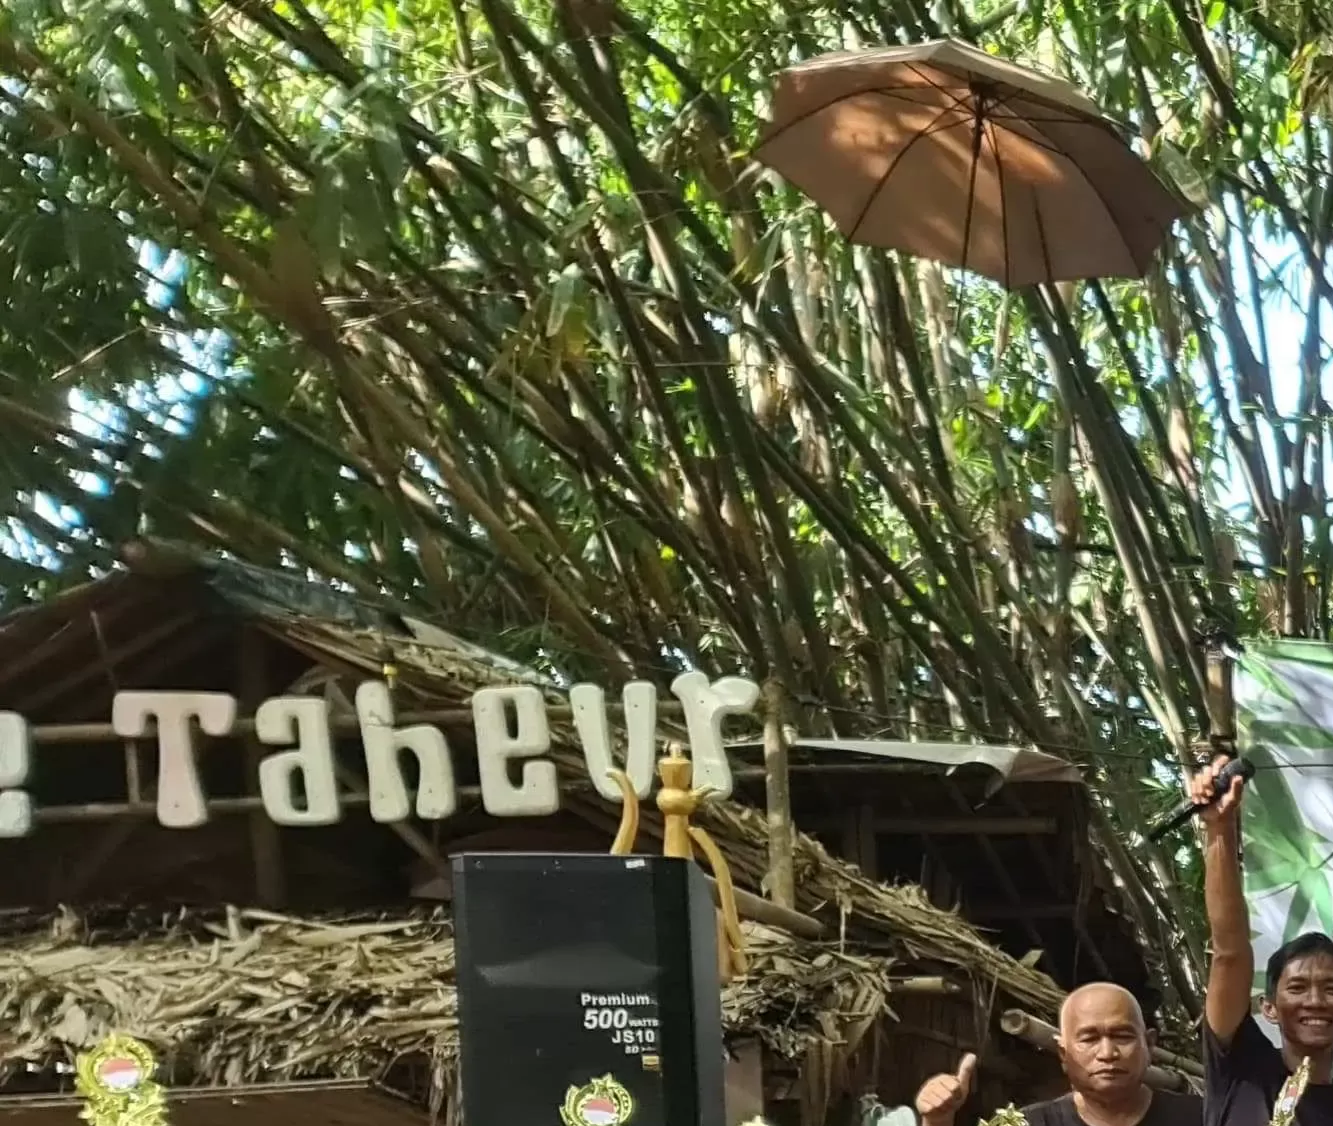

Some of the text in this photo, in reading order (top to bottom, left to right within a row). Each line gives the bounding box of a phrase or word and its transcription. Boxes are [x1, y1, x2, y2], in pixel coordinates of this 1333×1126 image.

[580, 991, 650, 1006] Premium
[583, 1008, 628, 1030] 500
[611, 1029, 656, 1044] JS10
